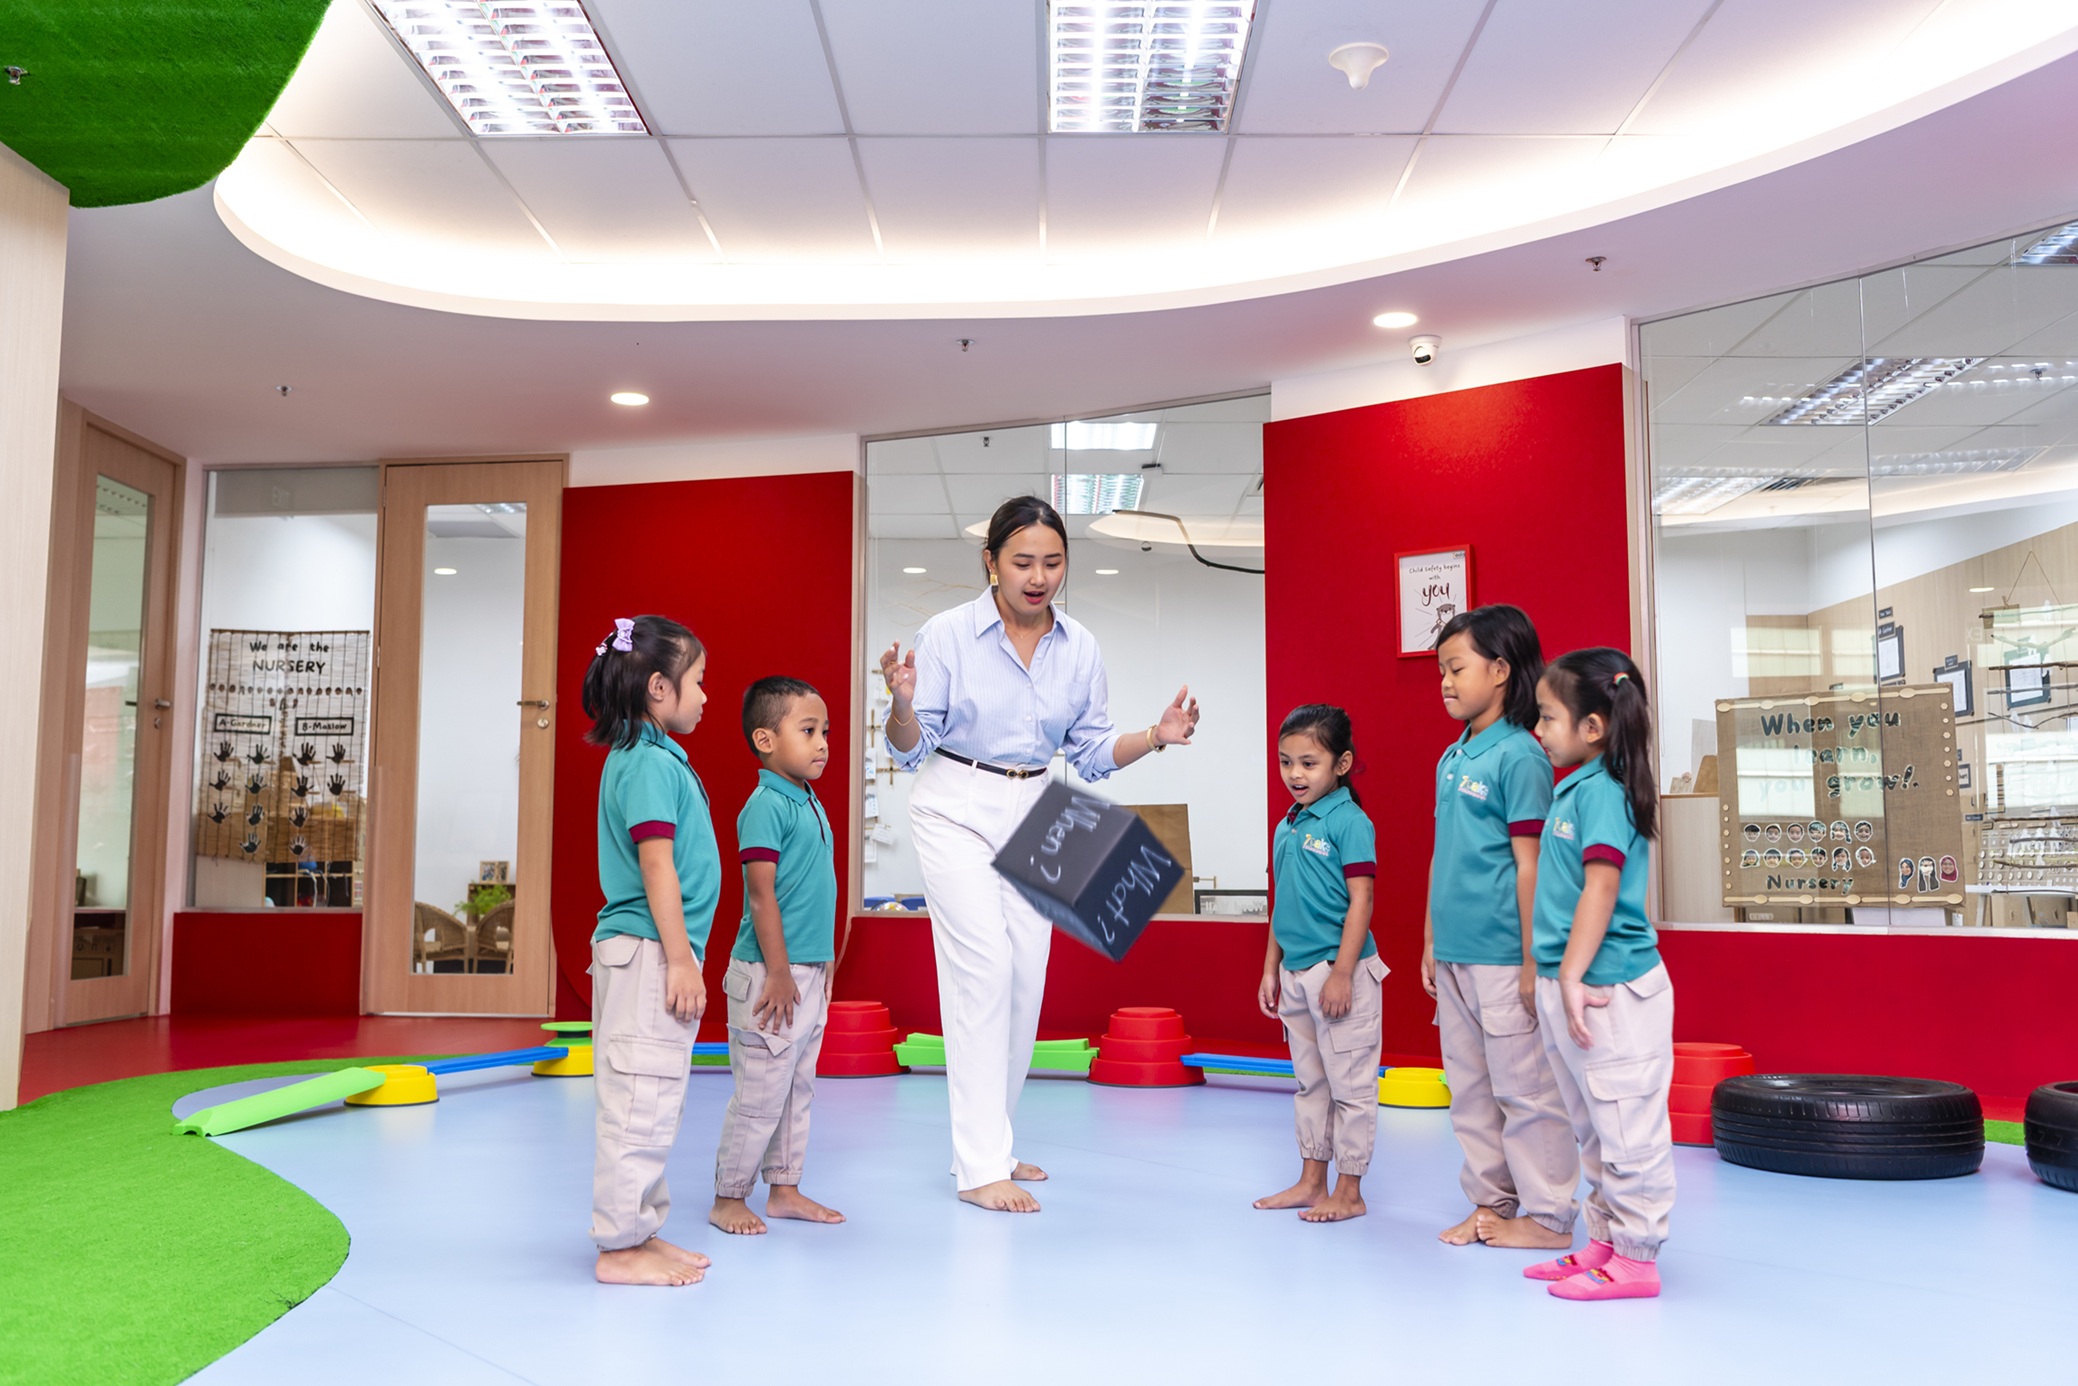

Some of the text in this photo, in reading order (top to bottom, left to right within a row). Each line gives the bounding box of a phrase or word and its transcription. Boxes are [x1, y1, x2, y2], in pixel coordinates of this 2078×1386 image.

[1422, 582, 1450, 607] you
[250, 641, 329, 653] We are the
[252, 659, 326, 675] NURSERY
[302, 722, 347, 731] B-Maslow
[1761, 712, 1900, 738] When you
[1793, 744, 1878, 764] learn,
[1759, 779, 1806, 801] you
[1030, 796, 1111, 884] When?
[1097, 844, 1172, 945] What?
[1767, 875, 1854, 895] Nursery
